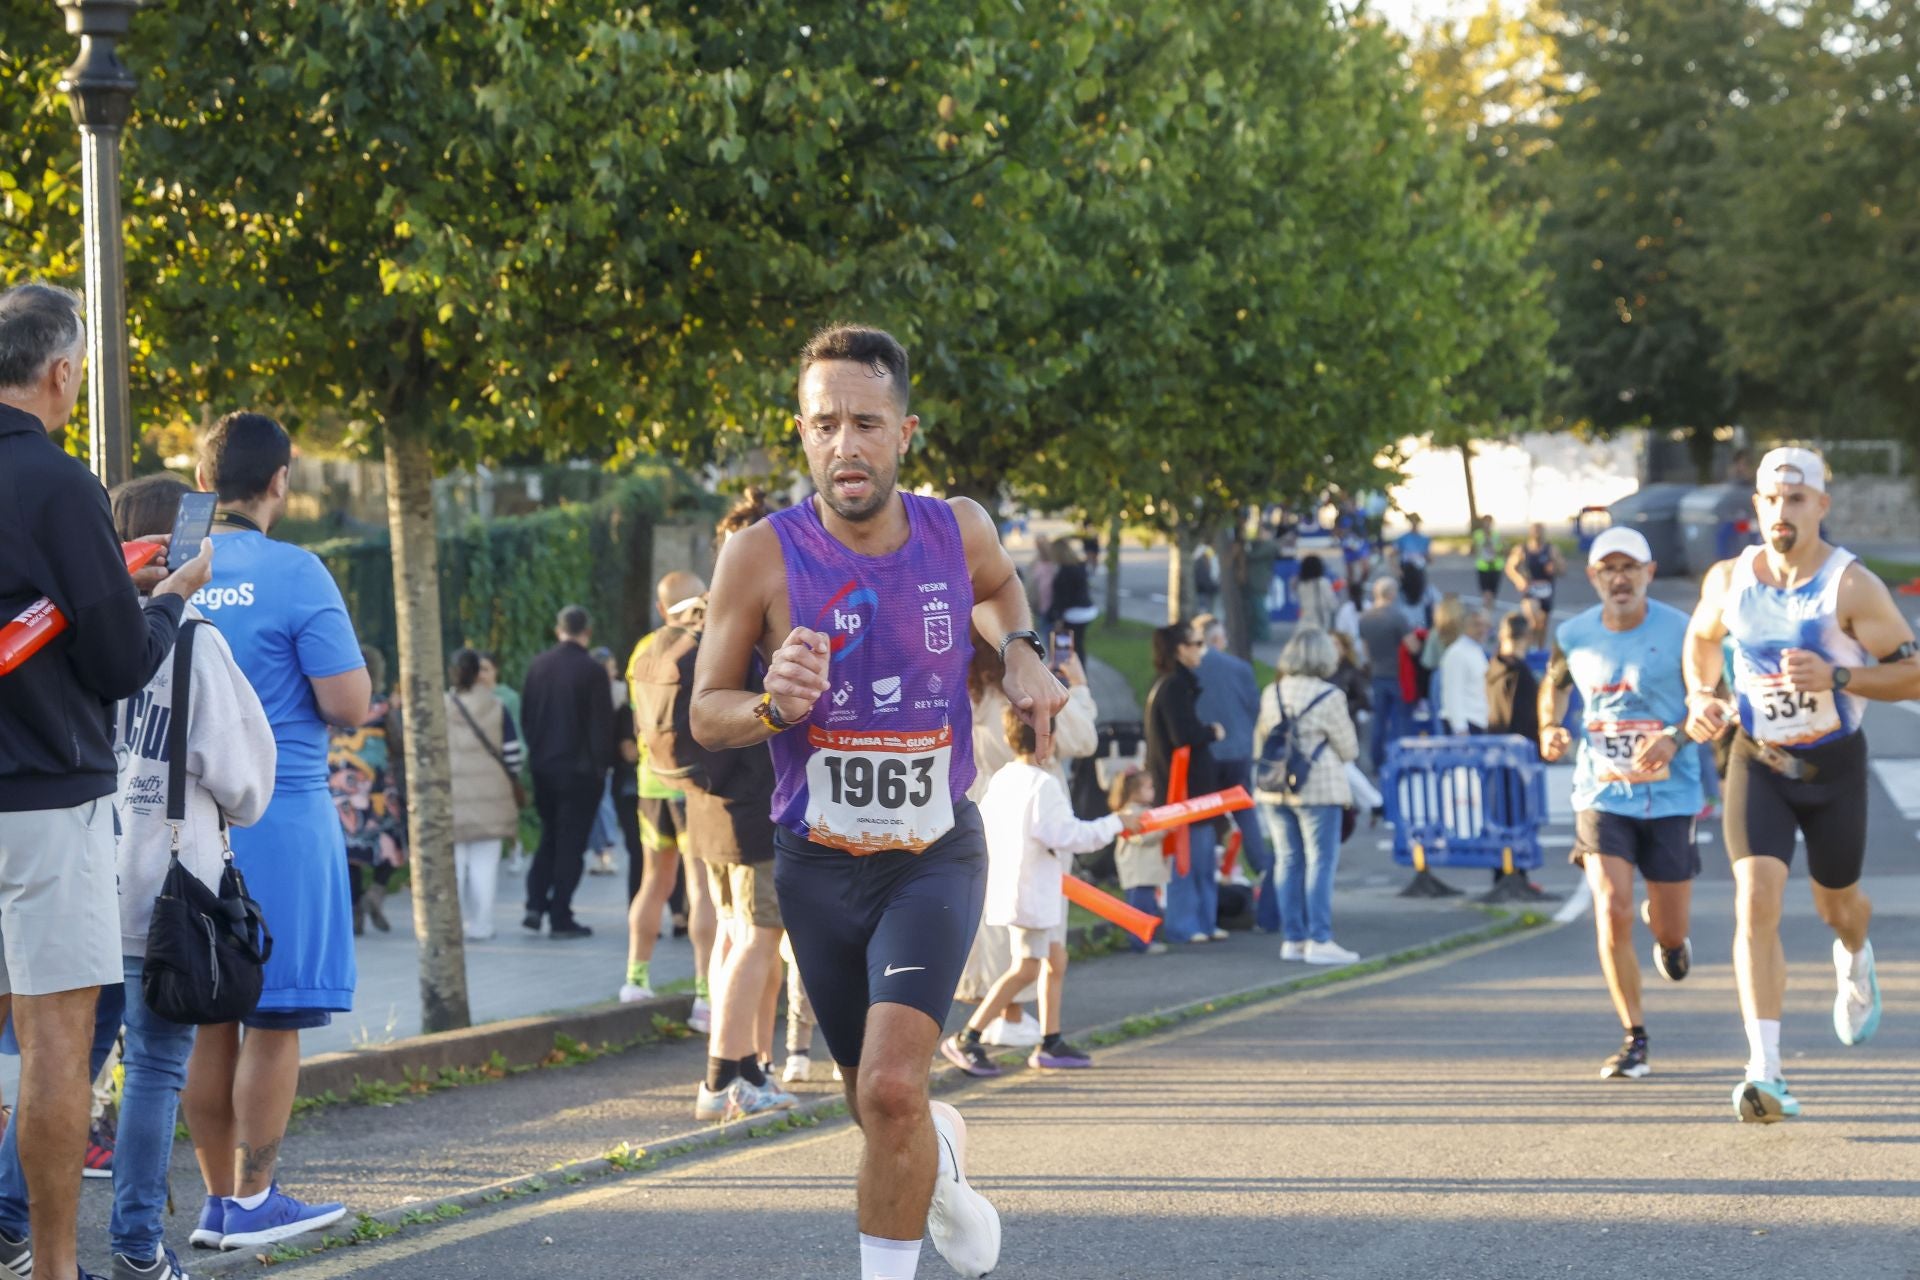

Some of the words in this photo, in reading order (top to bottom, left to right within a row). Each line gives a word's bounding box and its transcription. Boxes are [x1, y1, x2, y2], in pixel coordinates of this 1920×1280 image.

[188, 582, 254, 610] agoS
[833, 608, 862, 633] kp
[1763, 690, 1819, 722] 534
[824, 755, 936, 810] 1963
